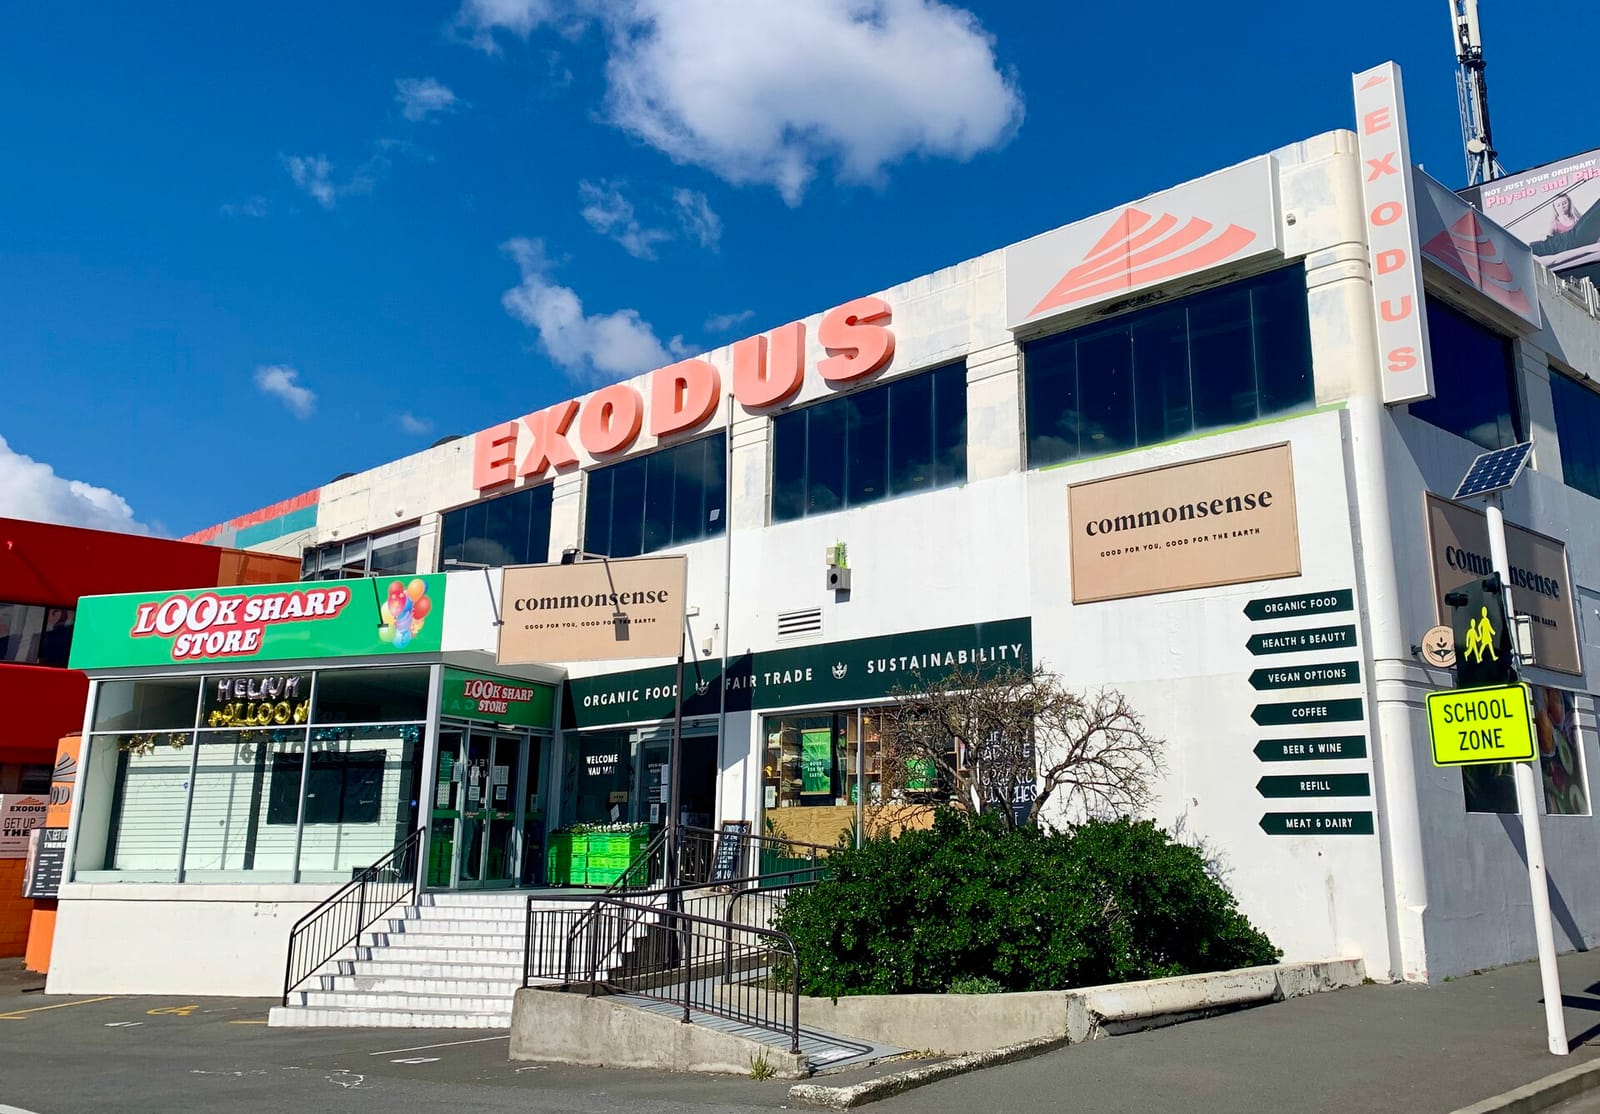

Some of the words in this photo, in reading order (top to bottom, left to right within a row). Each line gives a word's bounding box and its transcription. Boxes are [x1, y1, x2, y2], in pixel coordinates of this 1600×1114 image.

[1484, 187, 1501, 197] NOT
[1503, 181, 1524, 192] JUST
[1526, 173, 1550, 185] YOUR
[1551, 158, 1597, 178] ORDINARY
[1485, 187, 1536, 208] Physio
[1540, 174, 1568, 193] and
[1364, 107, 1417, 372] EXODUS
[473, 297, 895, 492] EXODUS
[1086, 490, 1273, 537] commonsense
[1100, 549, 1122, 557] GOOD
[1125, 546, 1140, 554] FOR
[1143, 543, 1162, 552] YOU,
[1166, 539, 1188, 547] GOOD
[1192, 536, 1209, 544] FOR
[1212, 532, 1228, 541] THE
[1232, 528, 1260, 538] EARTH
[1445, 545, 1559, 598] commnsense
[134, 596, 243, 634] LOOK
[244, 590, 346, 623] SHARP
[514, 590, 669, 612] commonsense
[1265, 601, 1306, 613] ORGANIC
[1310, 597, 1337, 608] FOOD
[174, 628, 261, 657] STORE
[1262, 637, 1297, 648] HEALTH
[1301, 636, 1306, 645] &
[1309, 632, 1346, 644] BEAUTY
[867, 643, 1022, 674] SUSTAINABILITY
[725, 675, 757, 690] FAIR
[764, 668, 813, 686] TRADE
[1268, 672, 1300, 683] VEGAN
[1304, 669, 1347, 680] OPTIONS
[464, 680, 500, 699] LOOK
[501, 687, 534, 701] SHARP
[583, 690, 639, 707] ORGANIC
[645, 685, 678, 701] FOOD
[478, 700, 507, 713] STORE
[1292, 707, 1327, 717] COFFEE
[1443, 698, 1513, 723] SCHOOL
[1283, 745, 1305, 754] BEER
[1309, 744, 1313, 753] &
[1318, 743, 1342, 753] WINE
[1458, 728, 1505, 751] ZONE
[586, 754, 618, 765] WELCOME
[1300, 781, 1330, 791] REFILL
[4, 818, 22, 829] GET
[23, 817, 36, 829] UP
[1286, 819, 1311, 828] MEAT
[1316, 818, 1321, 827] &
[1326, 818, 1353, 828] DAIRY
